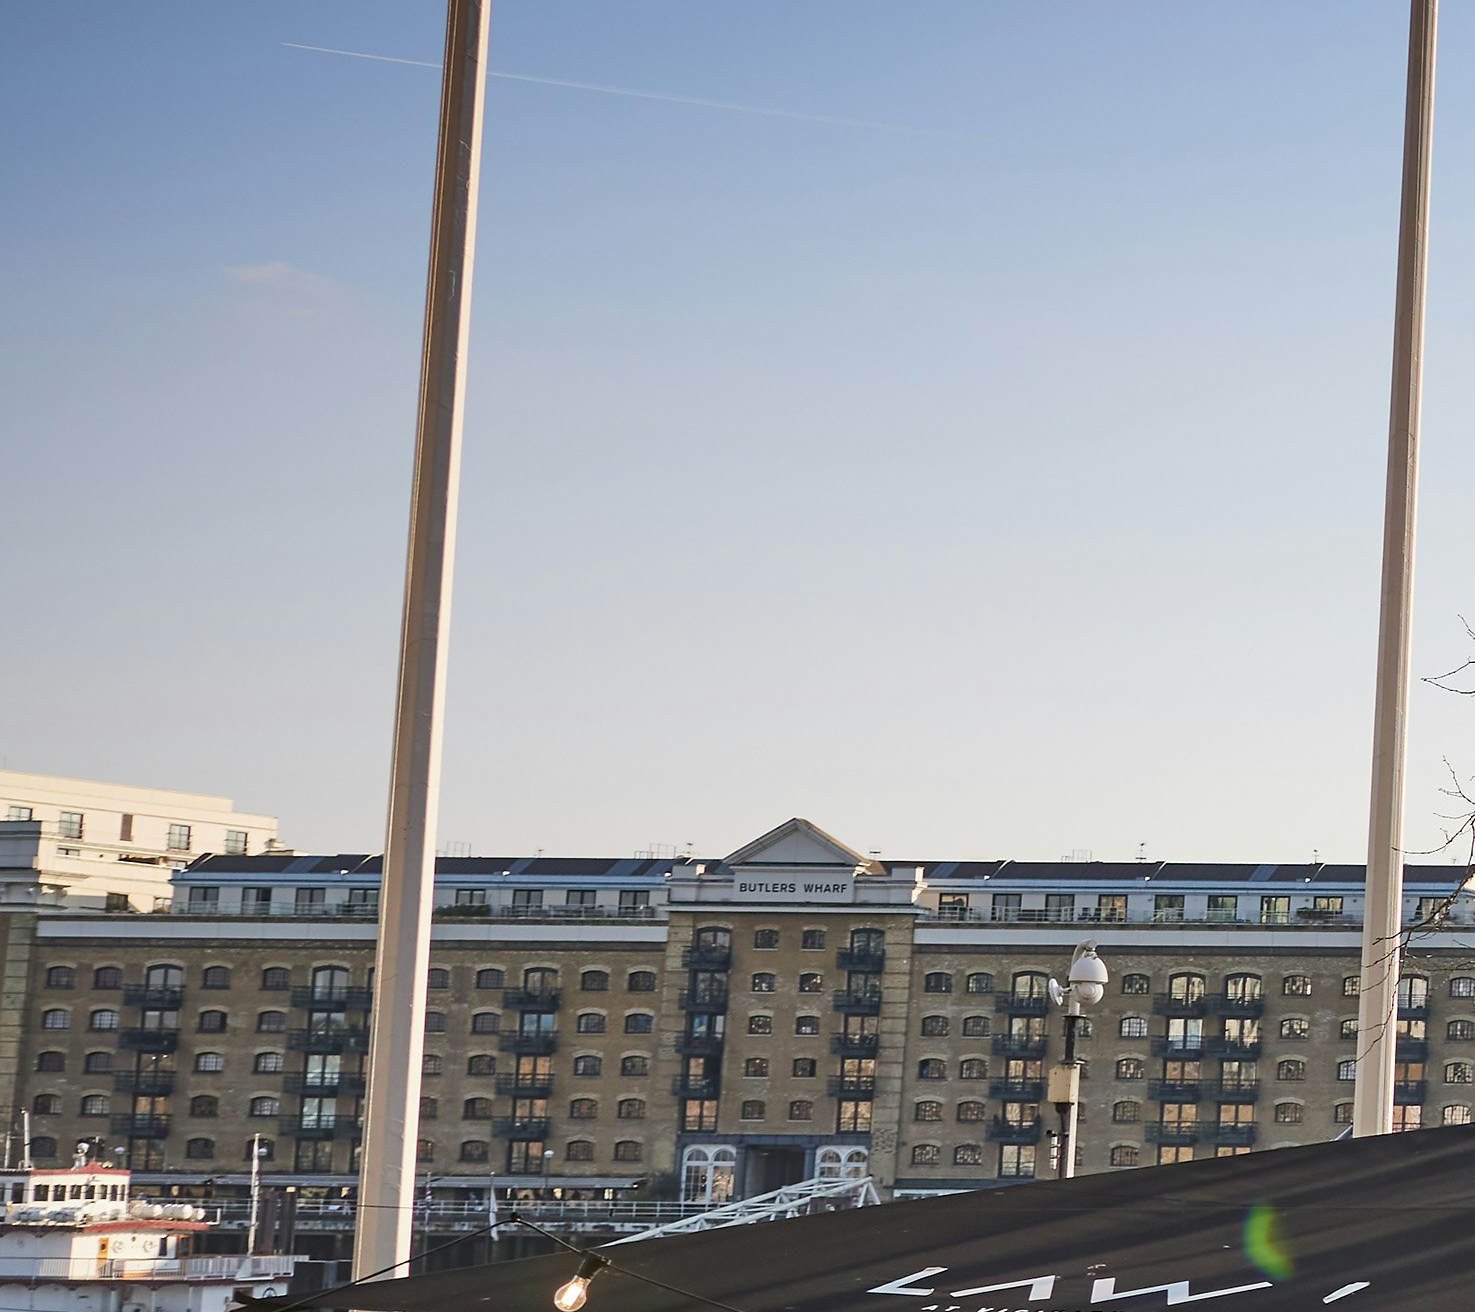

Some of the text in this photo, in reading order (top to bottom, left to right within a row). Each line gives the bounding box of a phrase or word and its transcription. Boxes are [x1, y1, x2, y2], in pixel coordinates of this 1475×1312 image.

[739, 882, 848, 894] BUTLERS WHARF
[921, 1304, 956, 1312] AT
